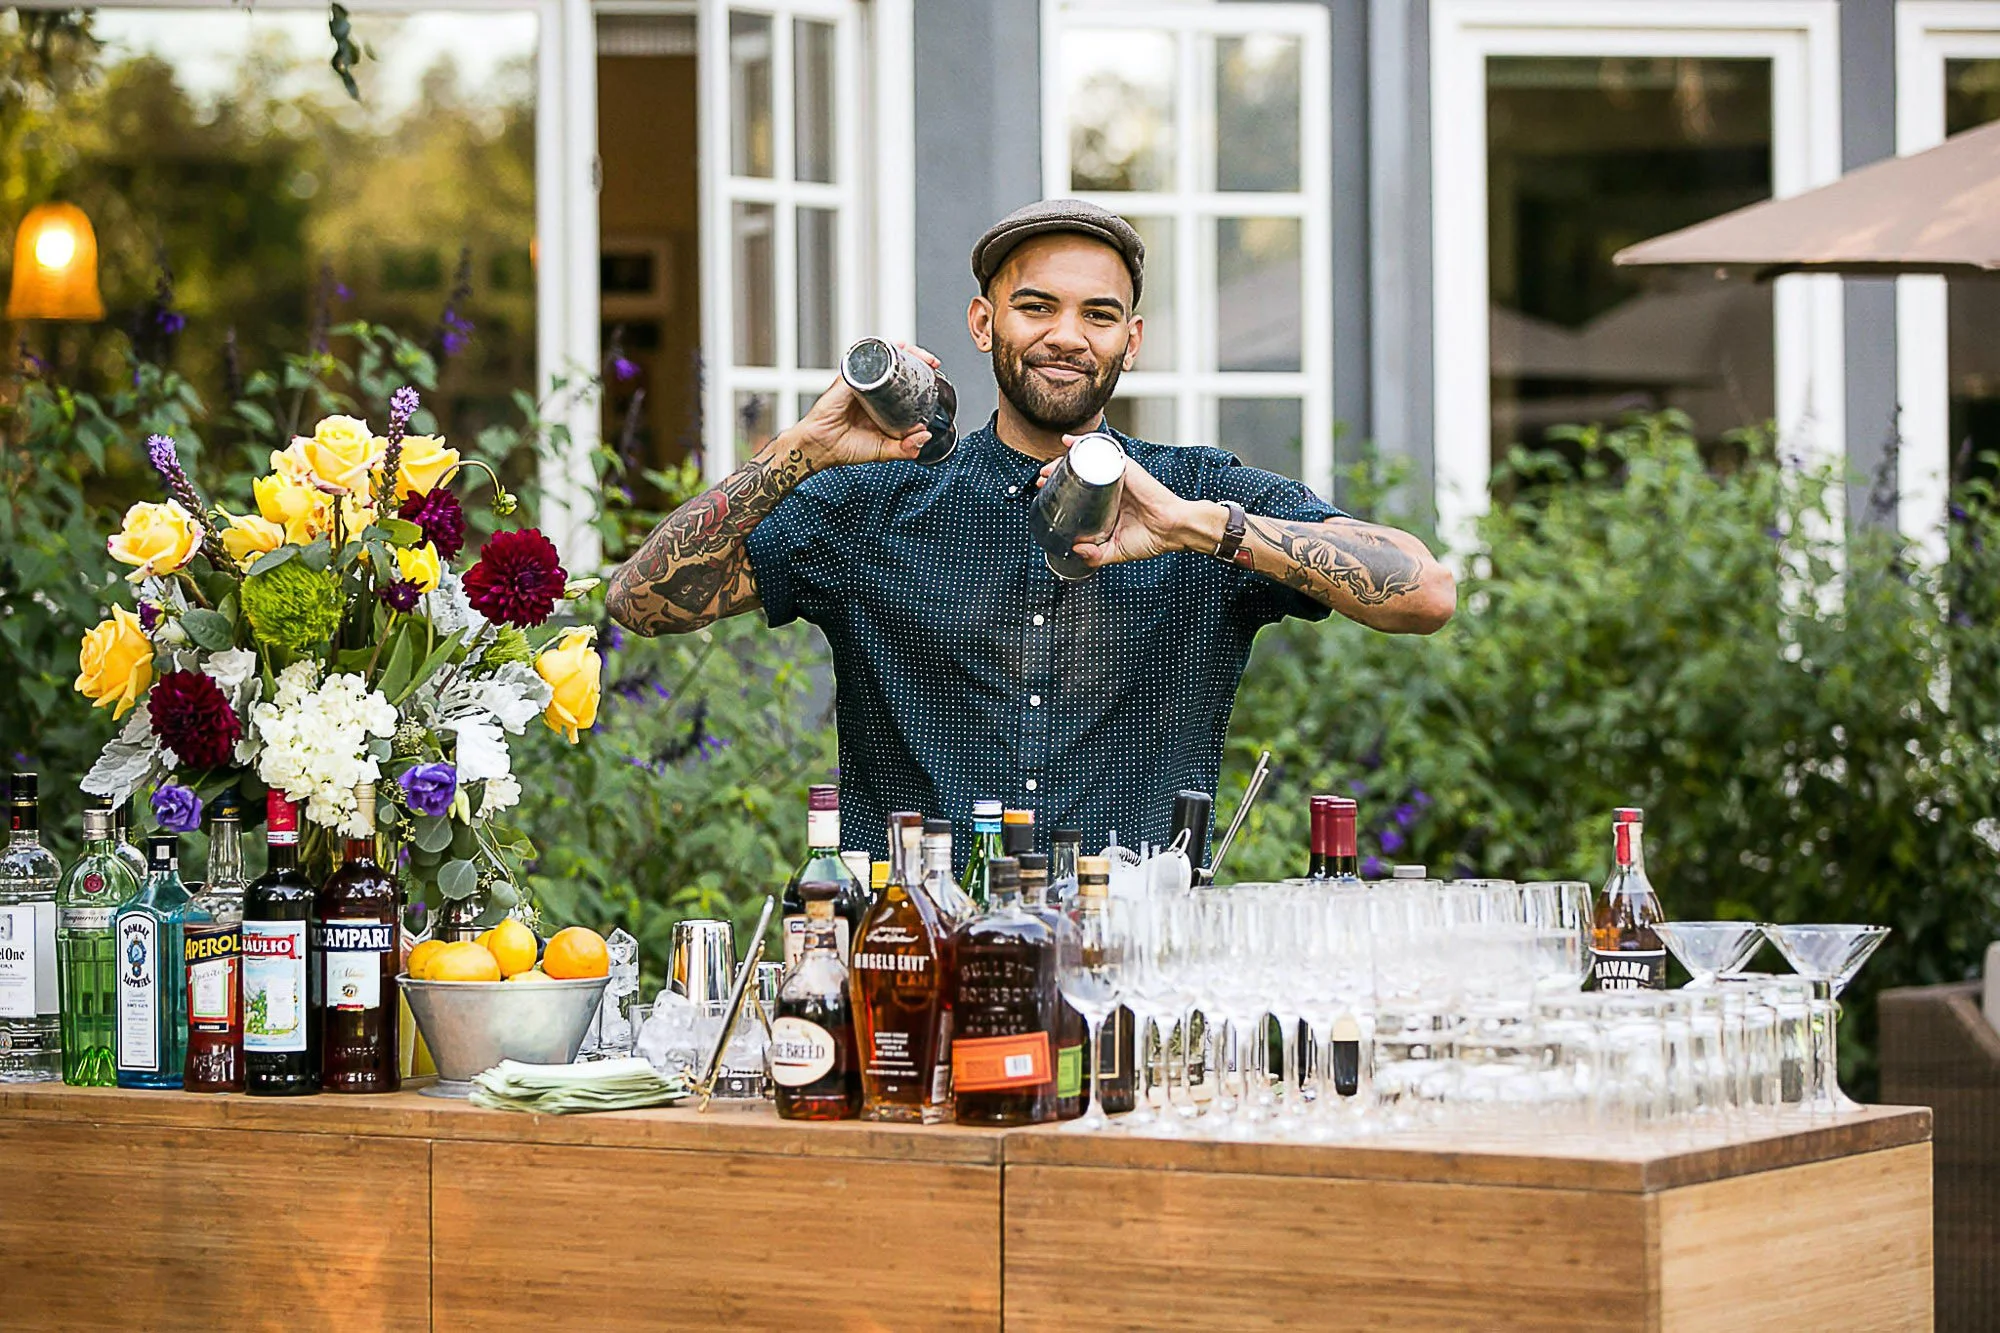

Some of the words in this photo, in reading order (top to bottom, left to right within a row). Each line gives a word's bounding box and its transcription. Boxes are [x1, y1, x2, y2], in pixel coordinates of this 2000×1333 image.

[123, 923, 149, 939] BOMBAY
[185, 933, 241, 960] APEROL
[123, 972, 151, 988] SAPPHIRE
[786, 1042, 825, 1059] BREED
